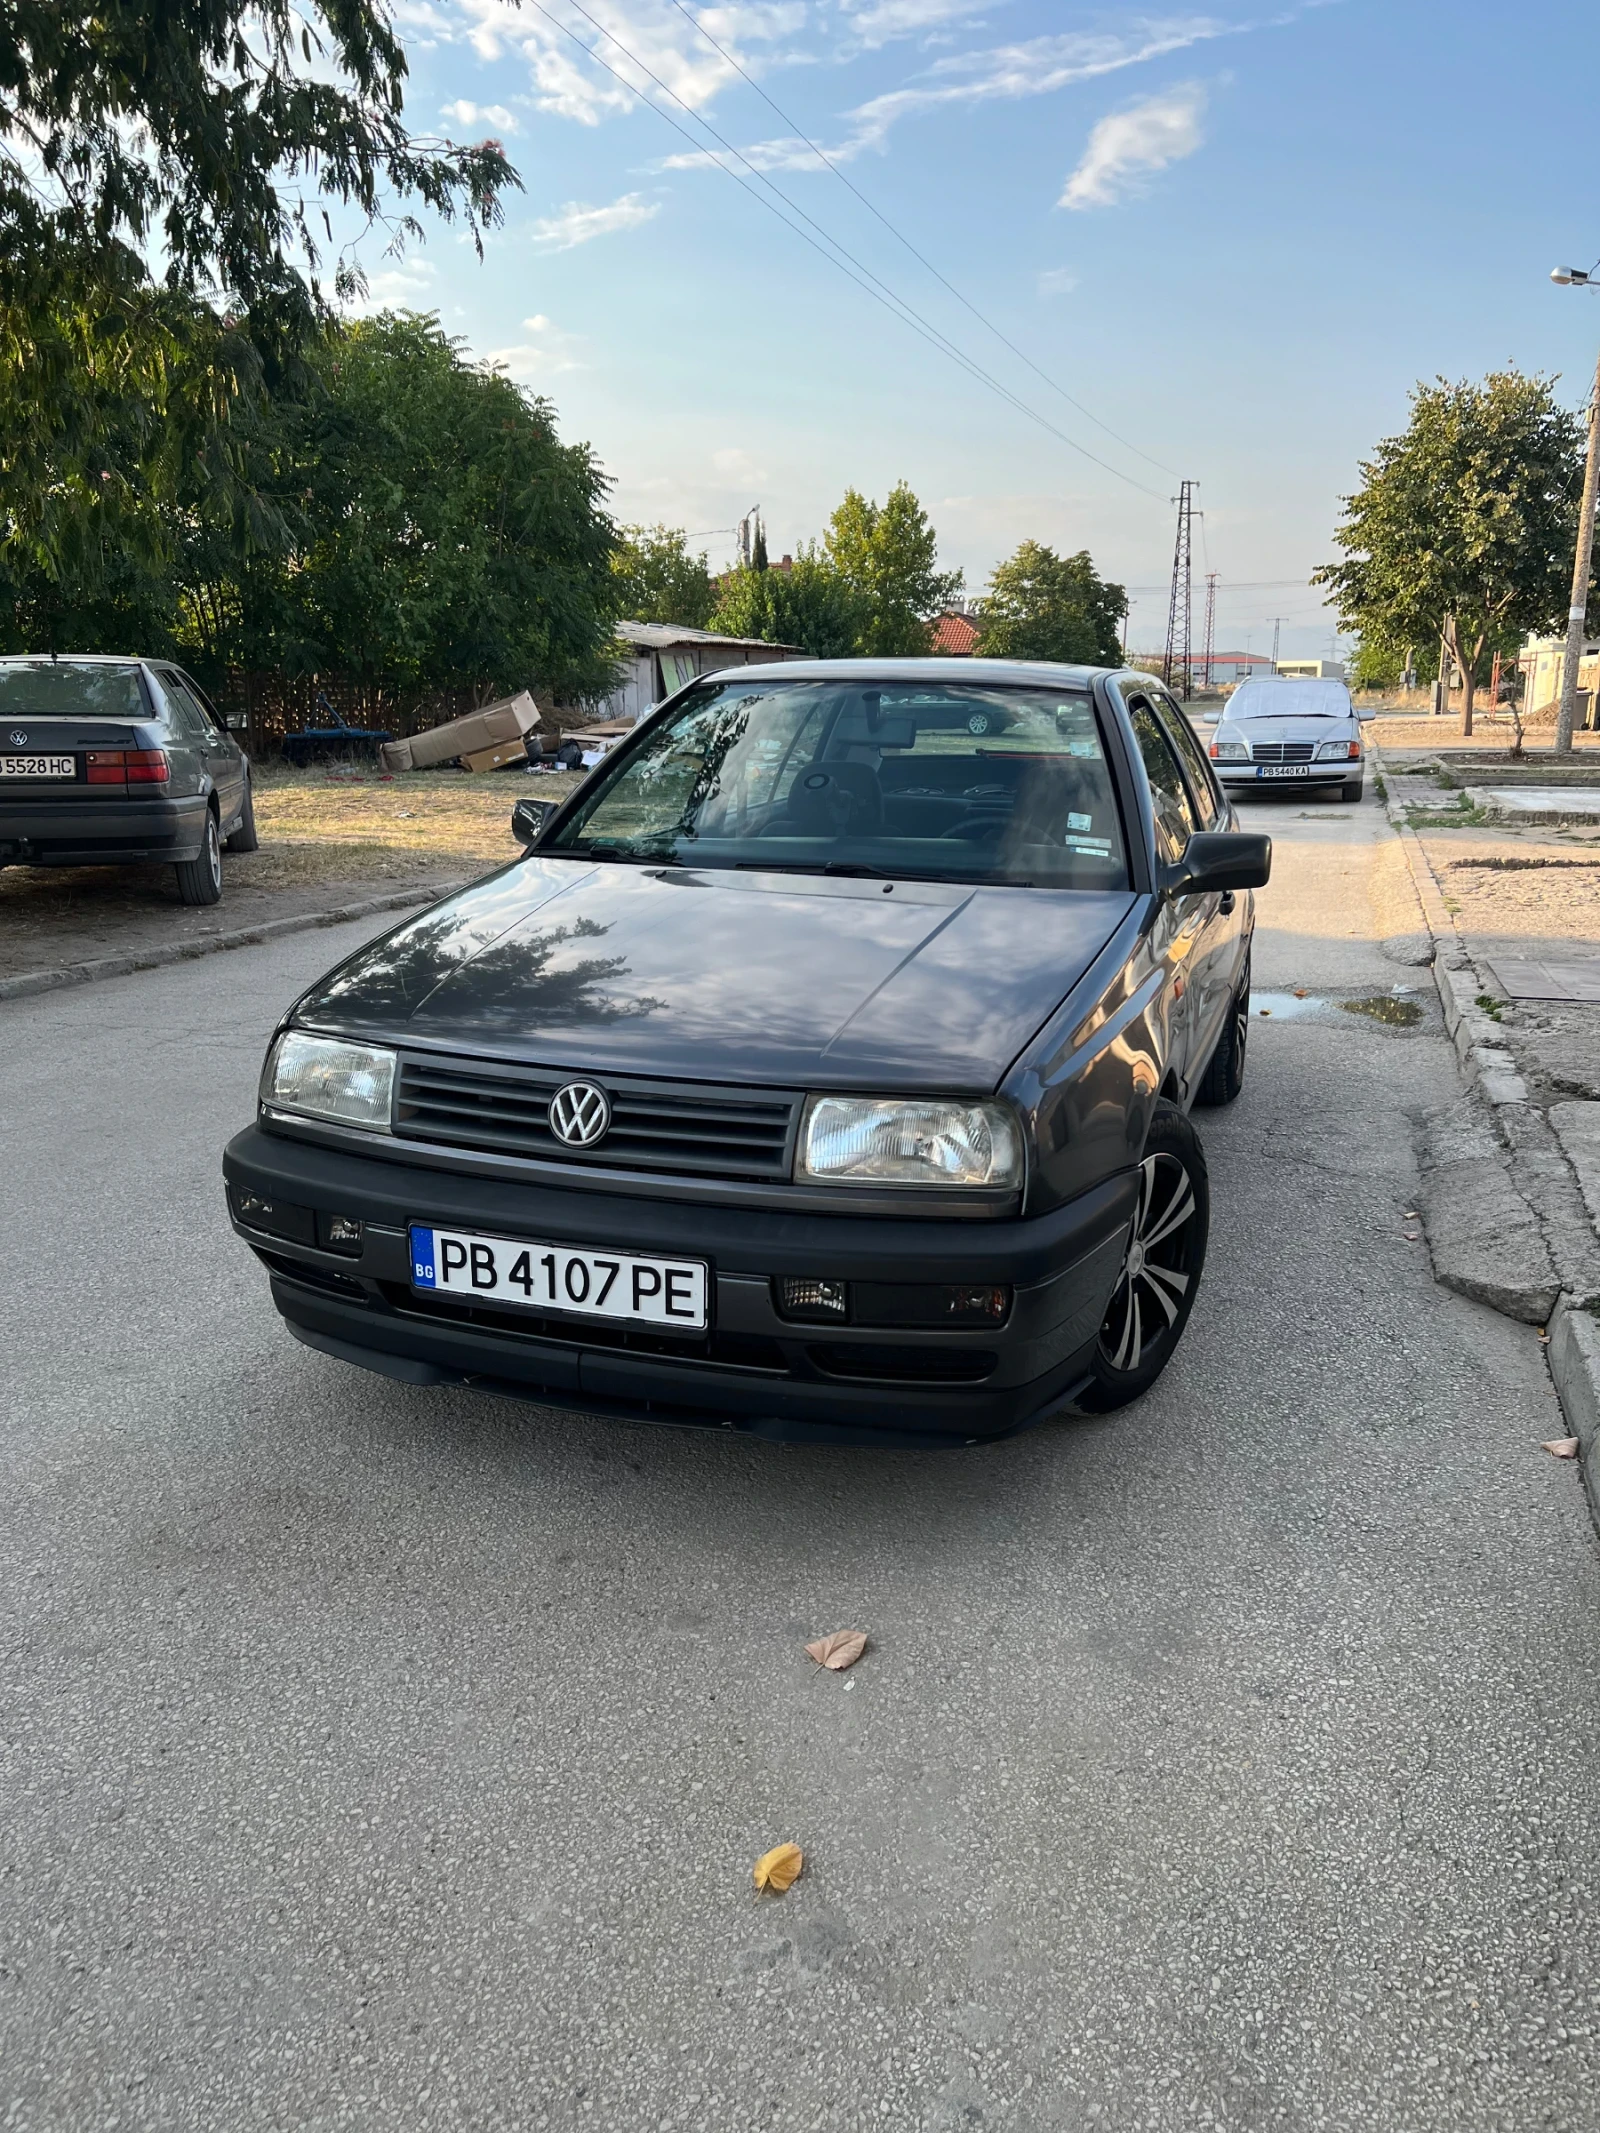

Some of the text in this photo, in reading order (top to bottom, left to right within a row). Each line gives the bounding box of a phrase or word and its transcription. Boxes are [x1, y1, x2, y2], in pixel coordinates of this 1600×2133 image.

[6, 759, 47, 774] 5528
[50, 759, 72, 774] HC
[1264, 767, 1306, 776] PB 5440 KA
[550, 1083, 607, 1145] VW
[415, 1263, 434, 1279] BG
[440, 1238, 695, 1318] PB 4107 PE
